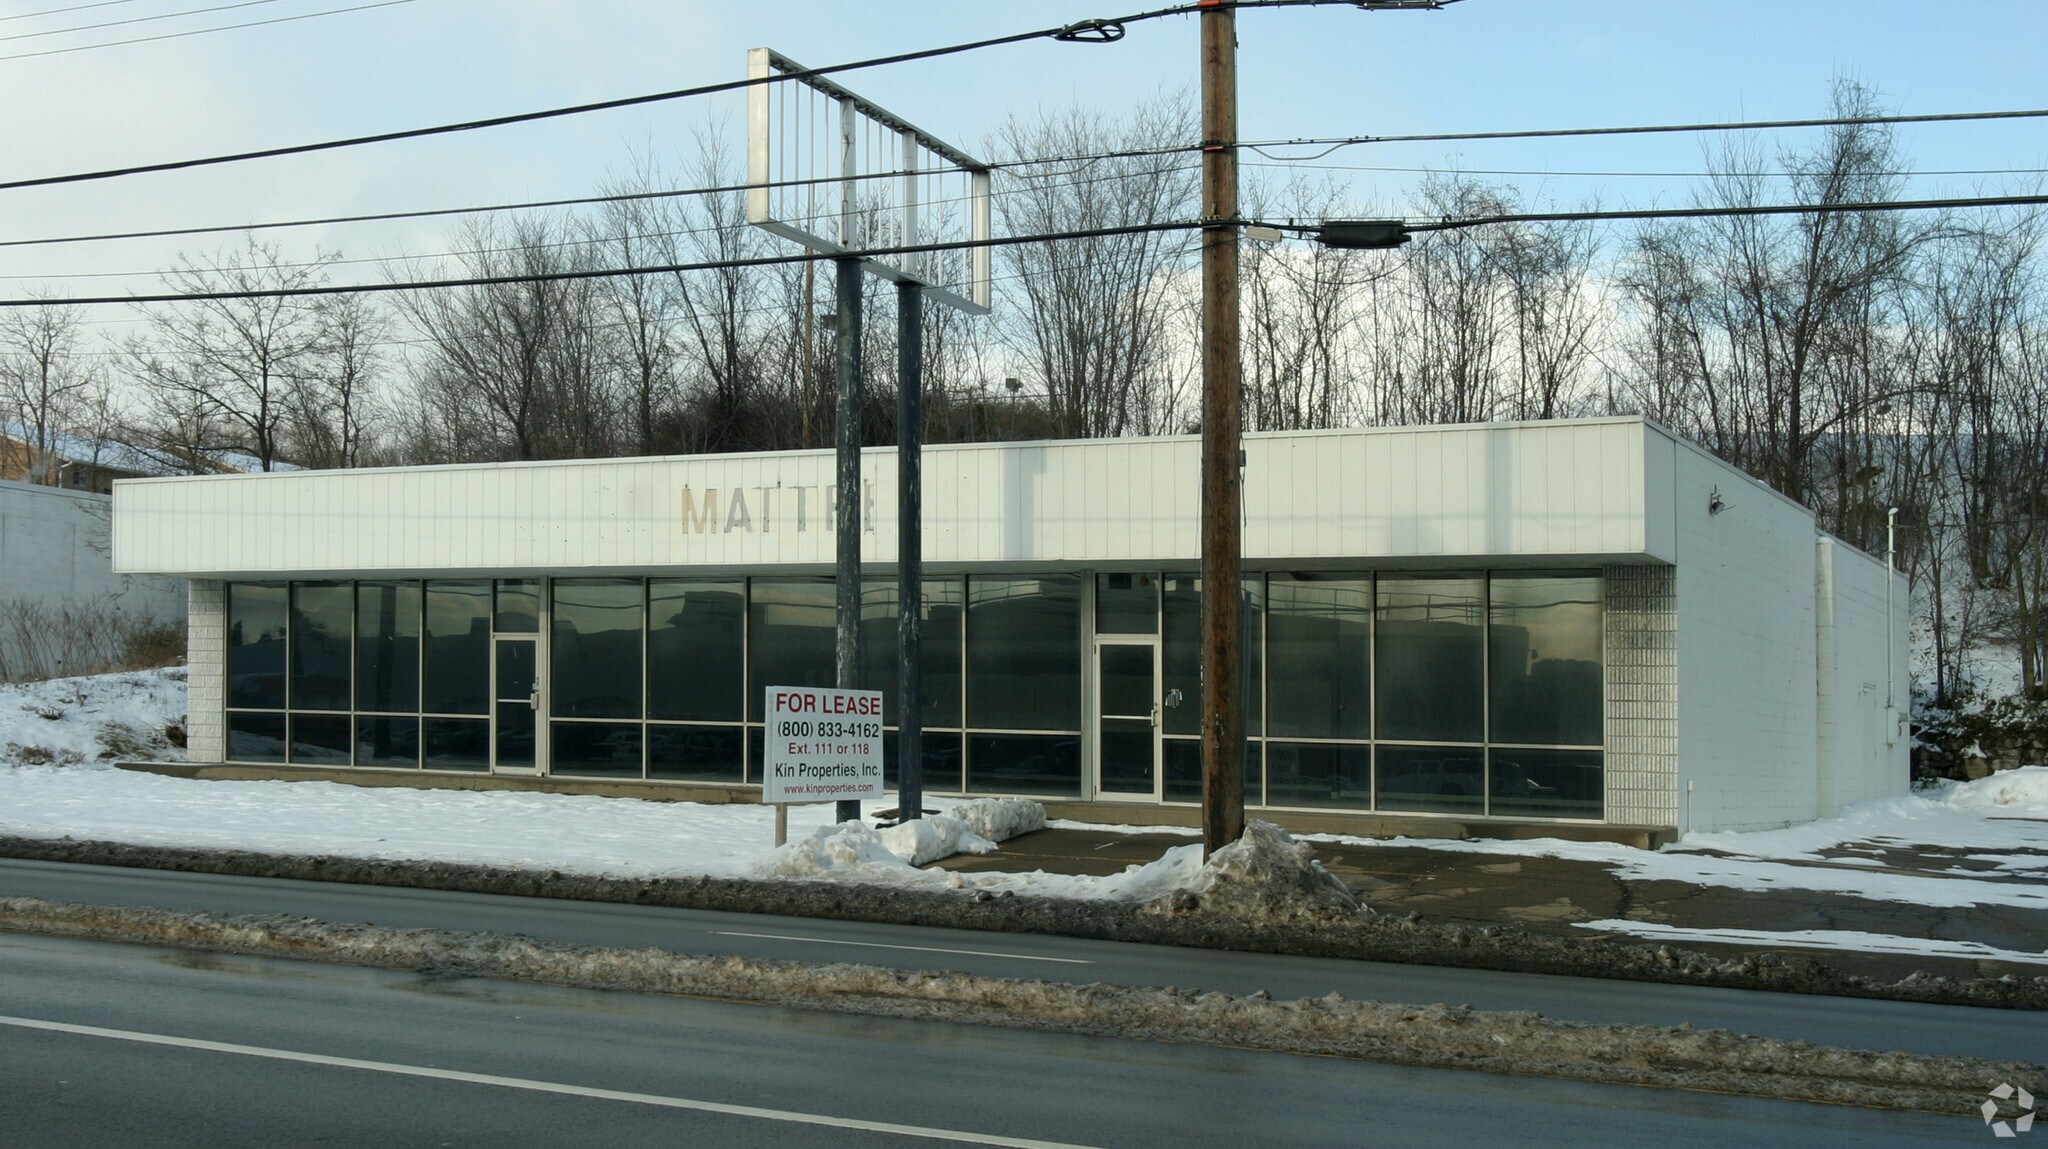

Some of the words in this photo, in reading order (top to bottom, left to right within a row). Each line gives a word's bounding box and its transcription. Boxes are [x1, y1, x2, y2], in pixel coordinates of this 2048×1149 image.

[775, 693, 816, 713] FOR
[822, 695, 881, 716] LEASE
[777, 721, 814, 738] (800)
[817, 722, 879, 738] 833-4162
[788, 742, 811, 755] Ext.
[815, 743, 832, 755] 111
[836, 746, 848, 755] or
[851, 743, 870, 755] 118
[775, 763, 795, 778] Kin
[798, 763, 859, 781] Properties,
[862, 763, 881, 777] Inc.
[783, 783, 874, 796] www.kinproperties.com
